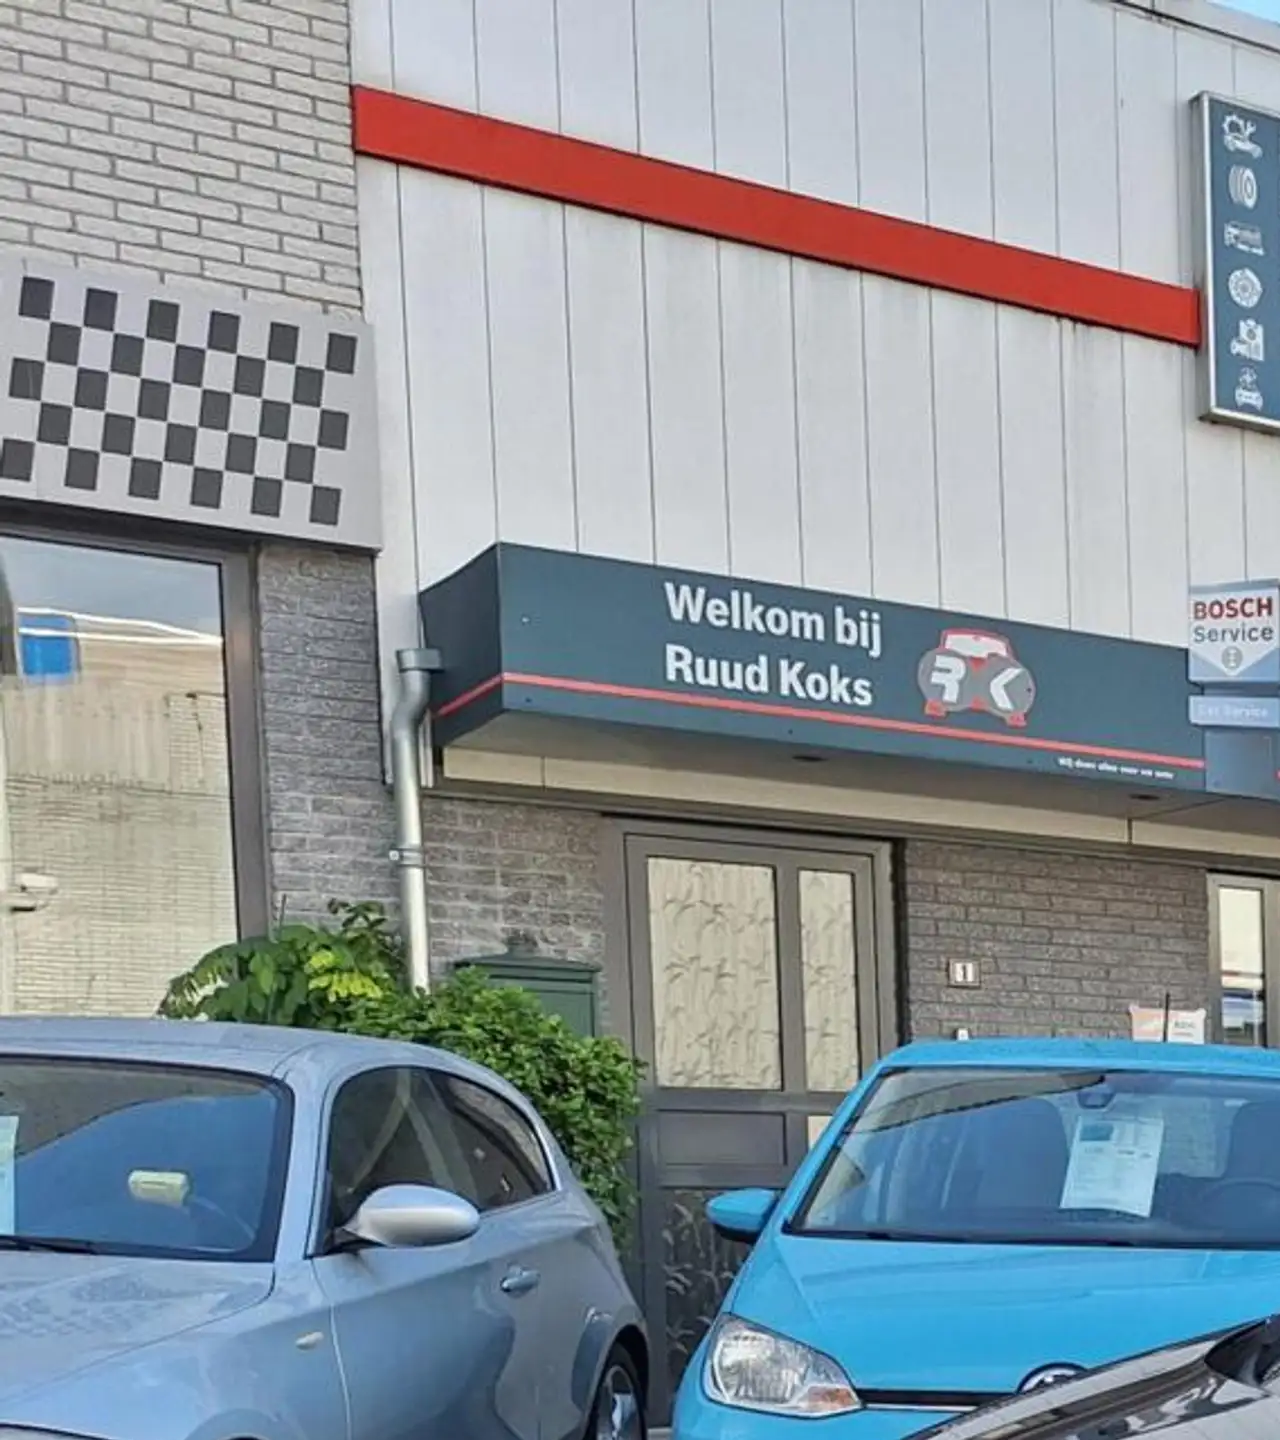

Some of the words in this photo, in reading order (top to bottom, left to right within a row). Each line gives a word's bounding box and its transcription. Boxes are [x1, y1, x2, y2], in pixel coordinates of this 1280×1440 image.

[664, 581, 826, 643] Welkom
[834, 605, 882, 659] bij
[1193, 595, 1273, 620] BOSCH
[1193, 622, 1274, 644] Service
[665, 643, 769, 695] Ruud
[779, 658, 873, 707] Koks
